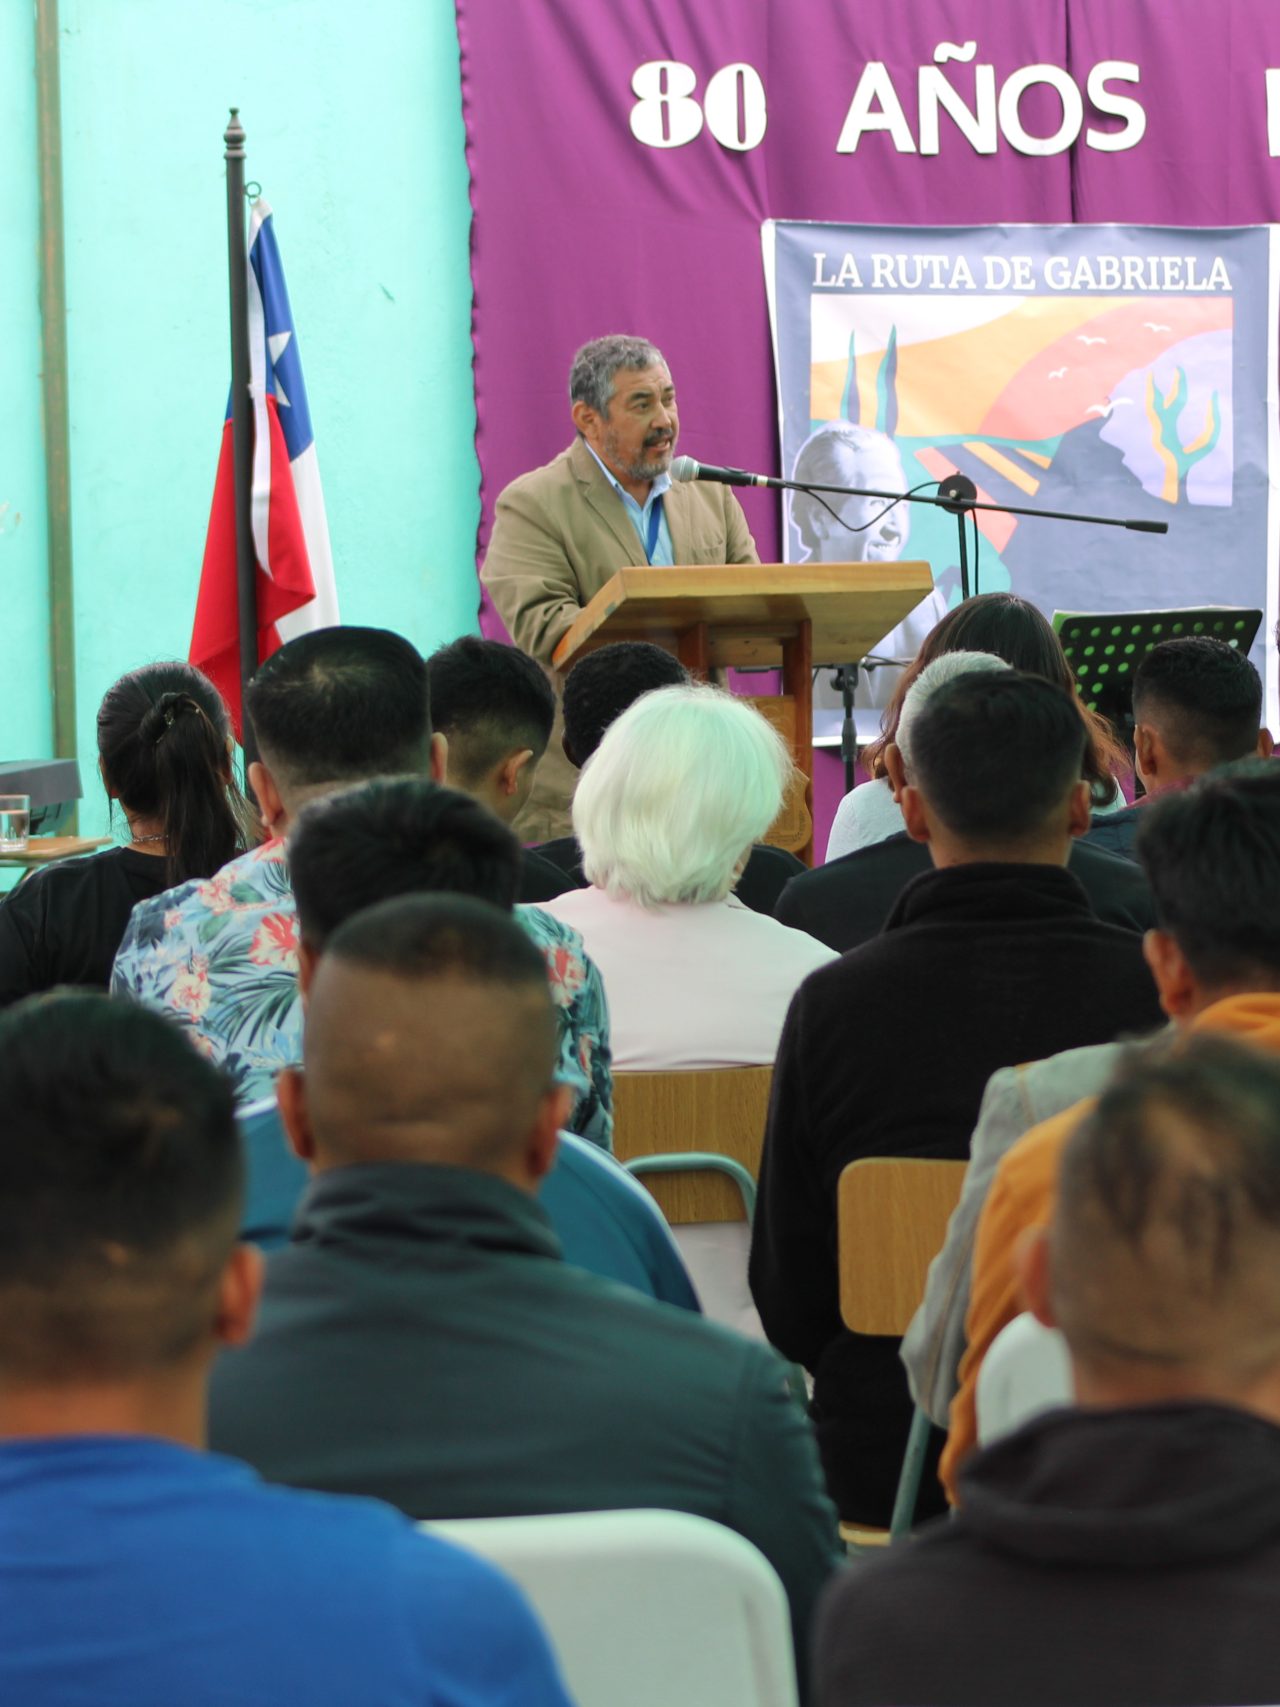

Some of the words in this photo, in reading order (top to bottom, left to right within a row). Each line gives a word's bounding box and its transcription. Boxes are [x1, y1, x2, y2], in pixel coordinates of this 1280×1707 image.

[630, 60, 768, 152] 80
[836, 41, 1147, 156] AÑOS
[812, 252, 863, 289] LA
[871, 253, 978, 291] RUTA
[984, 256, 1036, 291] DE
[1044, 256, 1233, 292] GABRIELA
